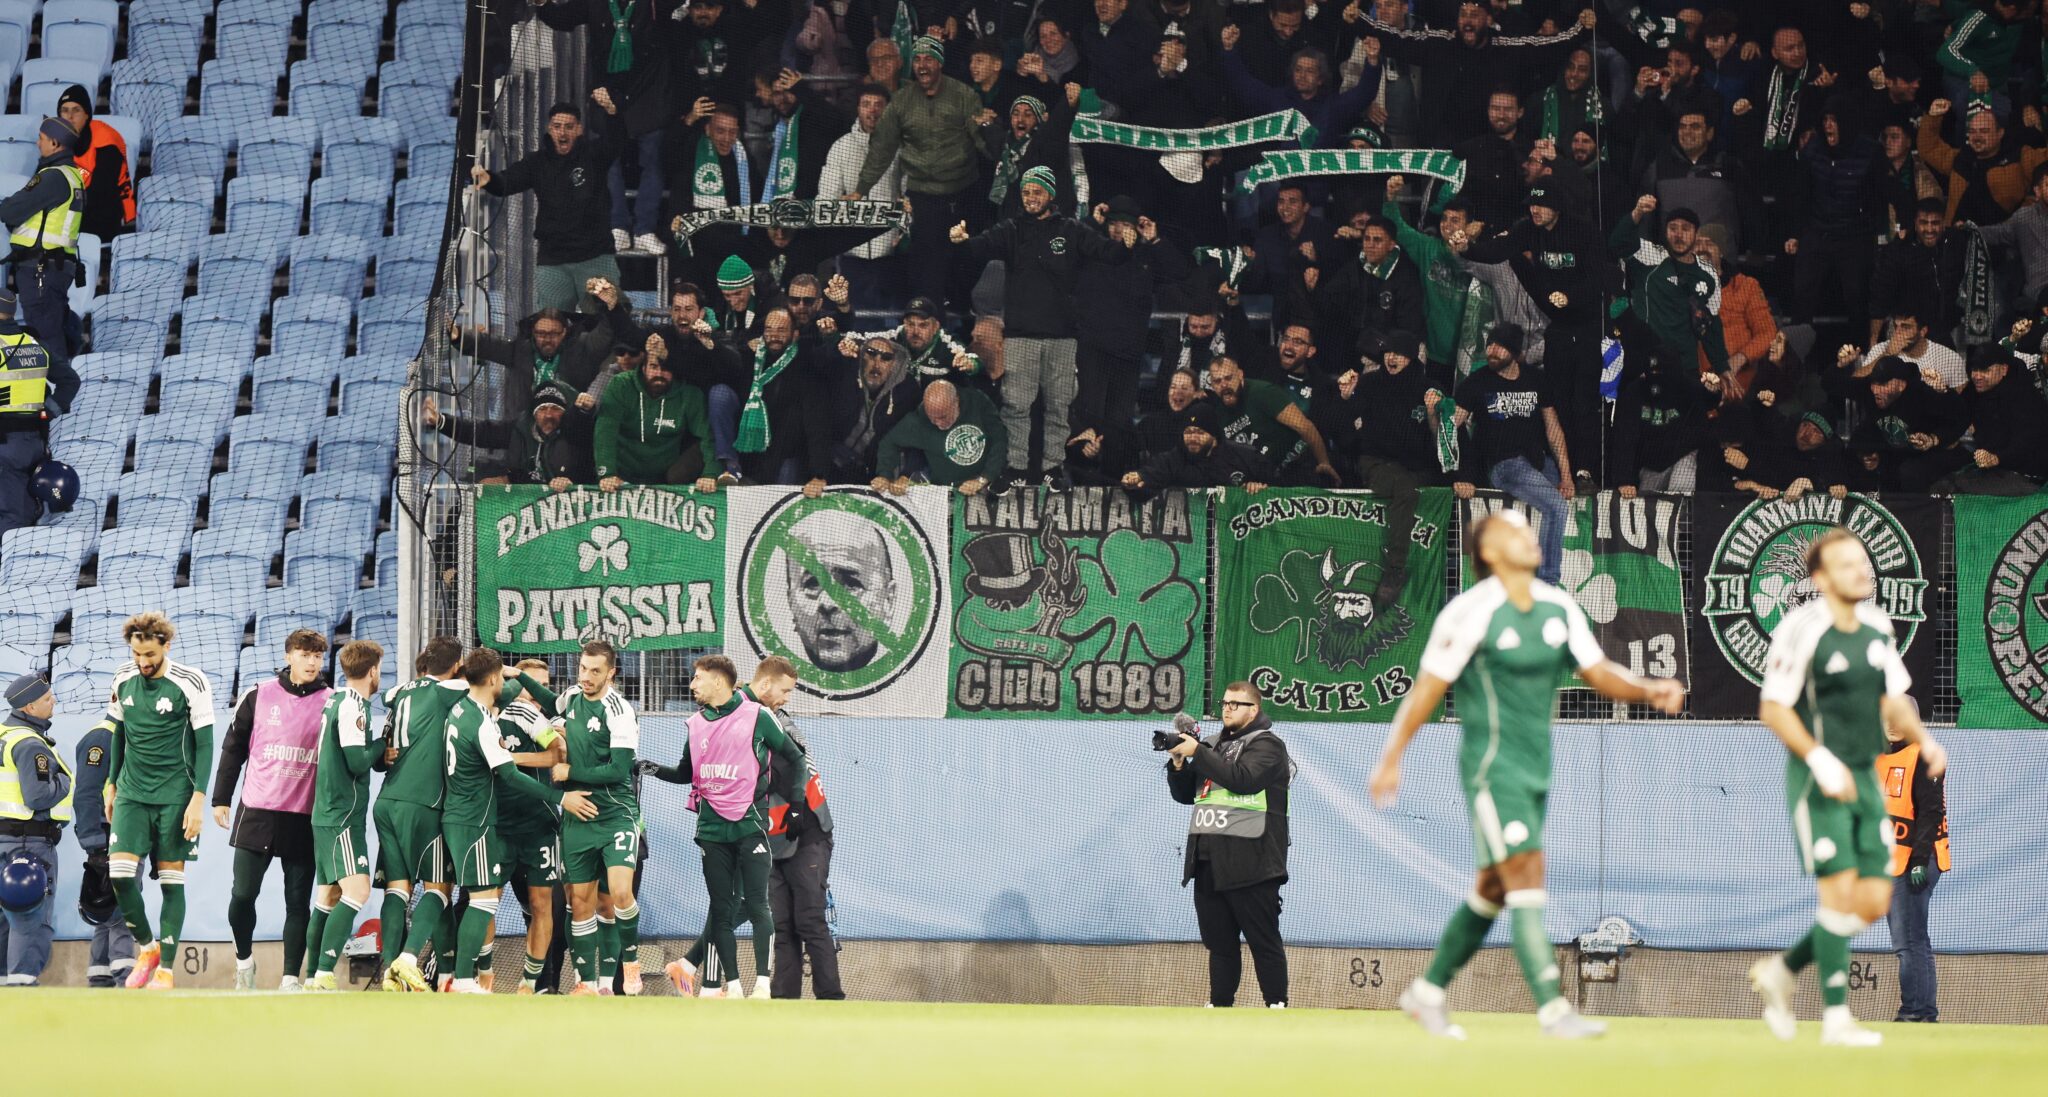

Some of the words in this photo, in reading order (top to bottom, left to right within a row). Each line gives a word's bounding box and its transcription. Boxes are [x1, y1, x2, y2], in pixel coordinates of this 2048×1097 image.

[814, 200, 893, 225] GATE
[496, 485, 716, 557] PANATHINAIKOS
[1723, 494, 1842, 569] IOANNINA
[1847, 504, 1908, 572] CLUB
[1719, 575, 1745, 611] 19
[1881, 577, 1914, 615] 99
[495, 582, 716, 643] PATISSIA
[1628, 633, 1677, 678] 13
[957, 657, 1058, 707] Club
[1072, 662, 1183, 711] 1989
[1249, 666, 1370, 712] GATE
[1372, 665, 1414, 705] 13
[1195, 808, 1229, 828] 003
[613, 831, 636, 851] 27
[184, 946, 208, 975] 81
[1350, 957, 1383, 988] 83
[1848, 961, 1877, 990] 84
